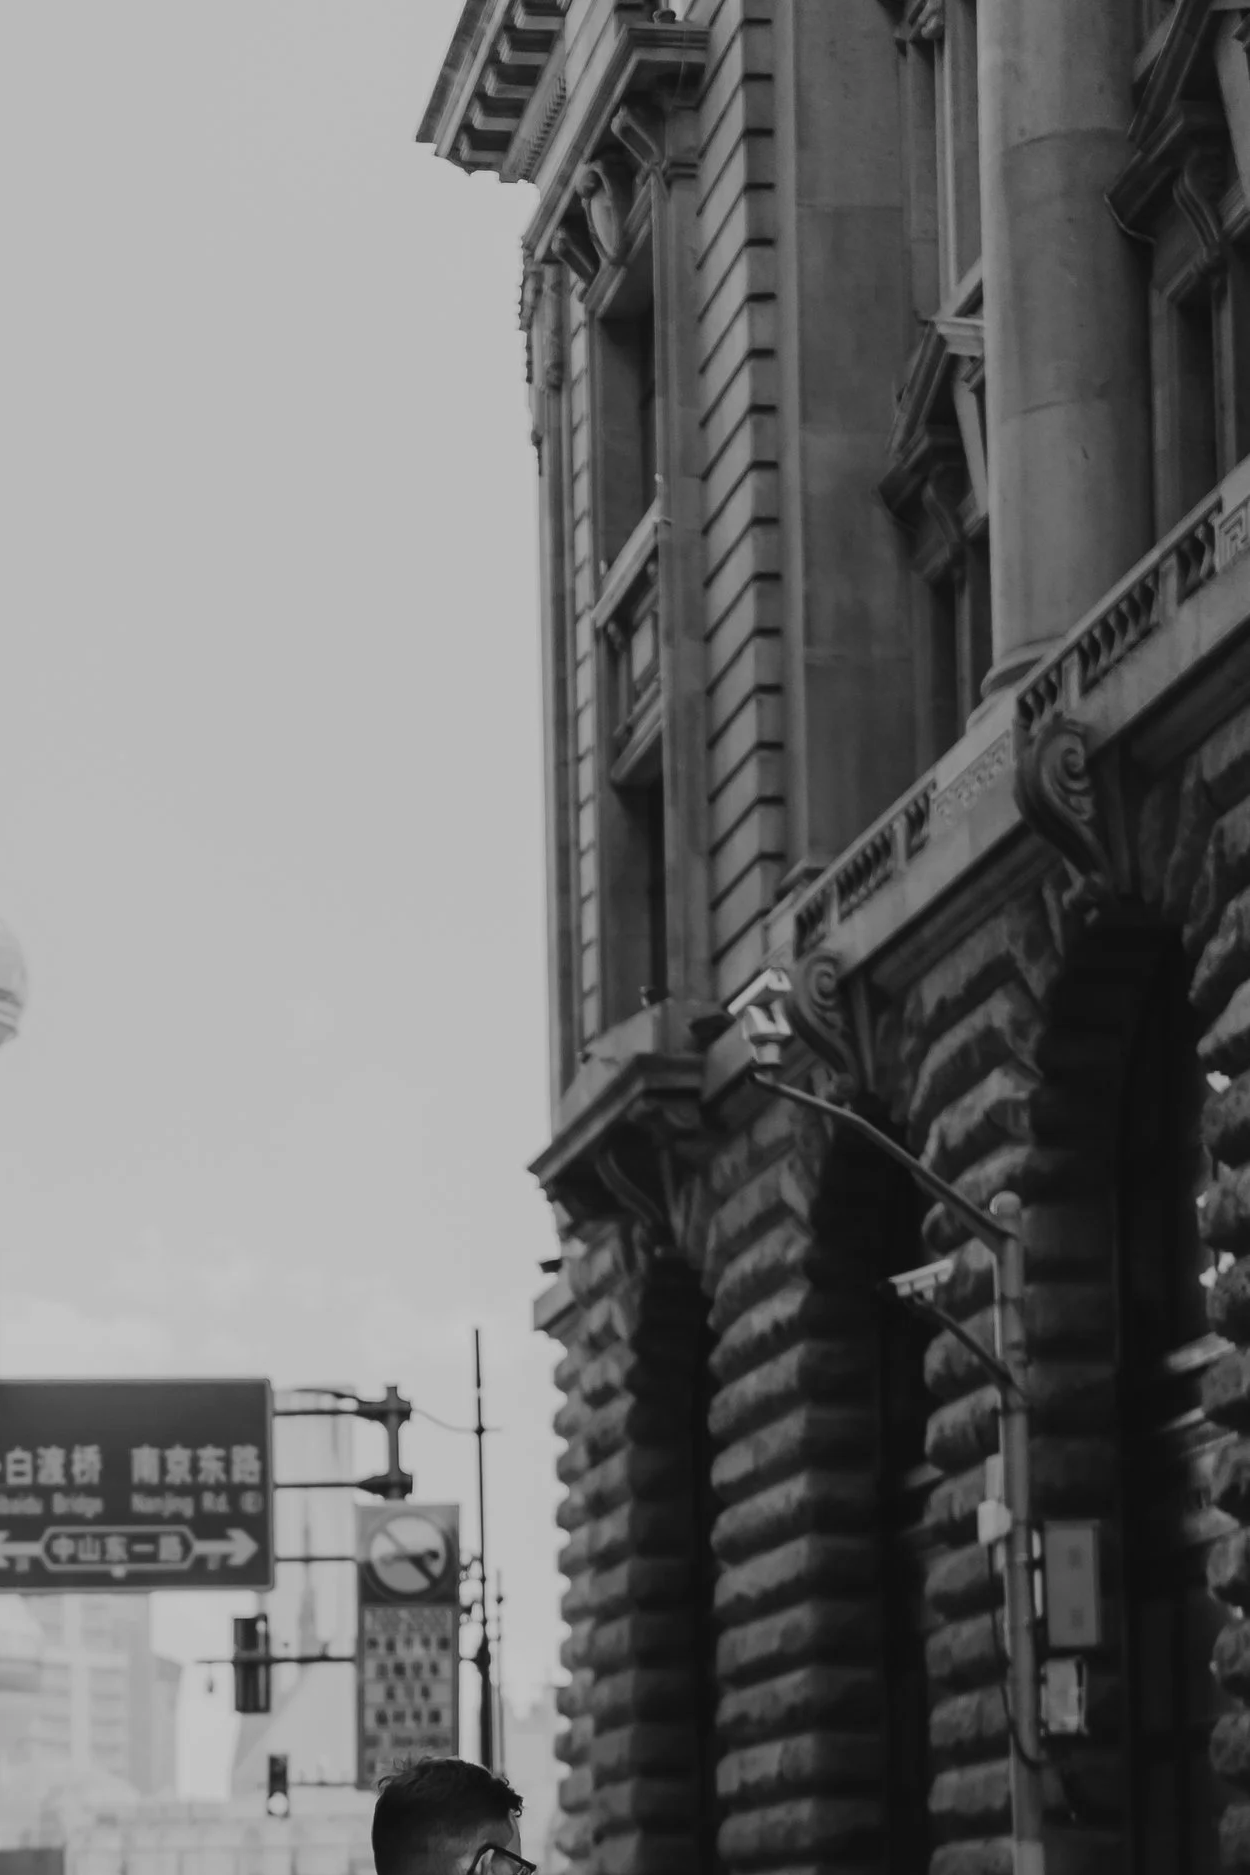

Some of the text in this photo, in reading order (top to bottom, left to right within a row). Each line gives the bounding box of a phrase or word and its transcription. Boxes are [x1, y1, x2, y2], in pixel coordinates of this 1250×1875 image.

[130, 1443, 261, 1486] 南京东路
[52, 1533, 183, 1563] 中山东一路
